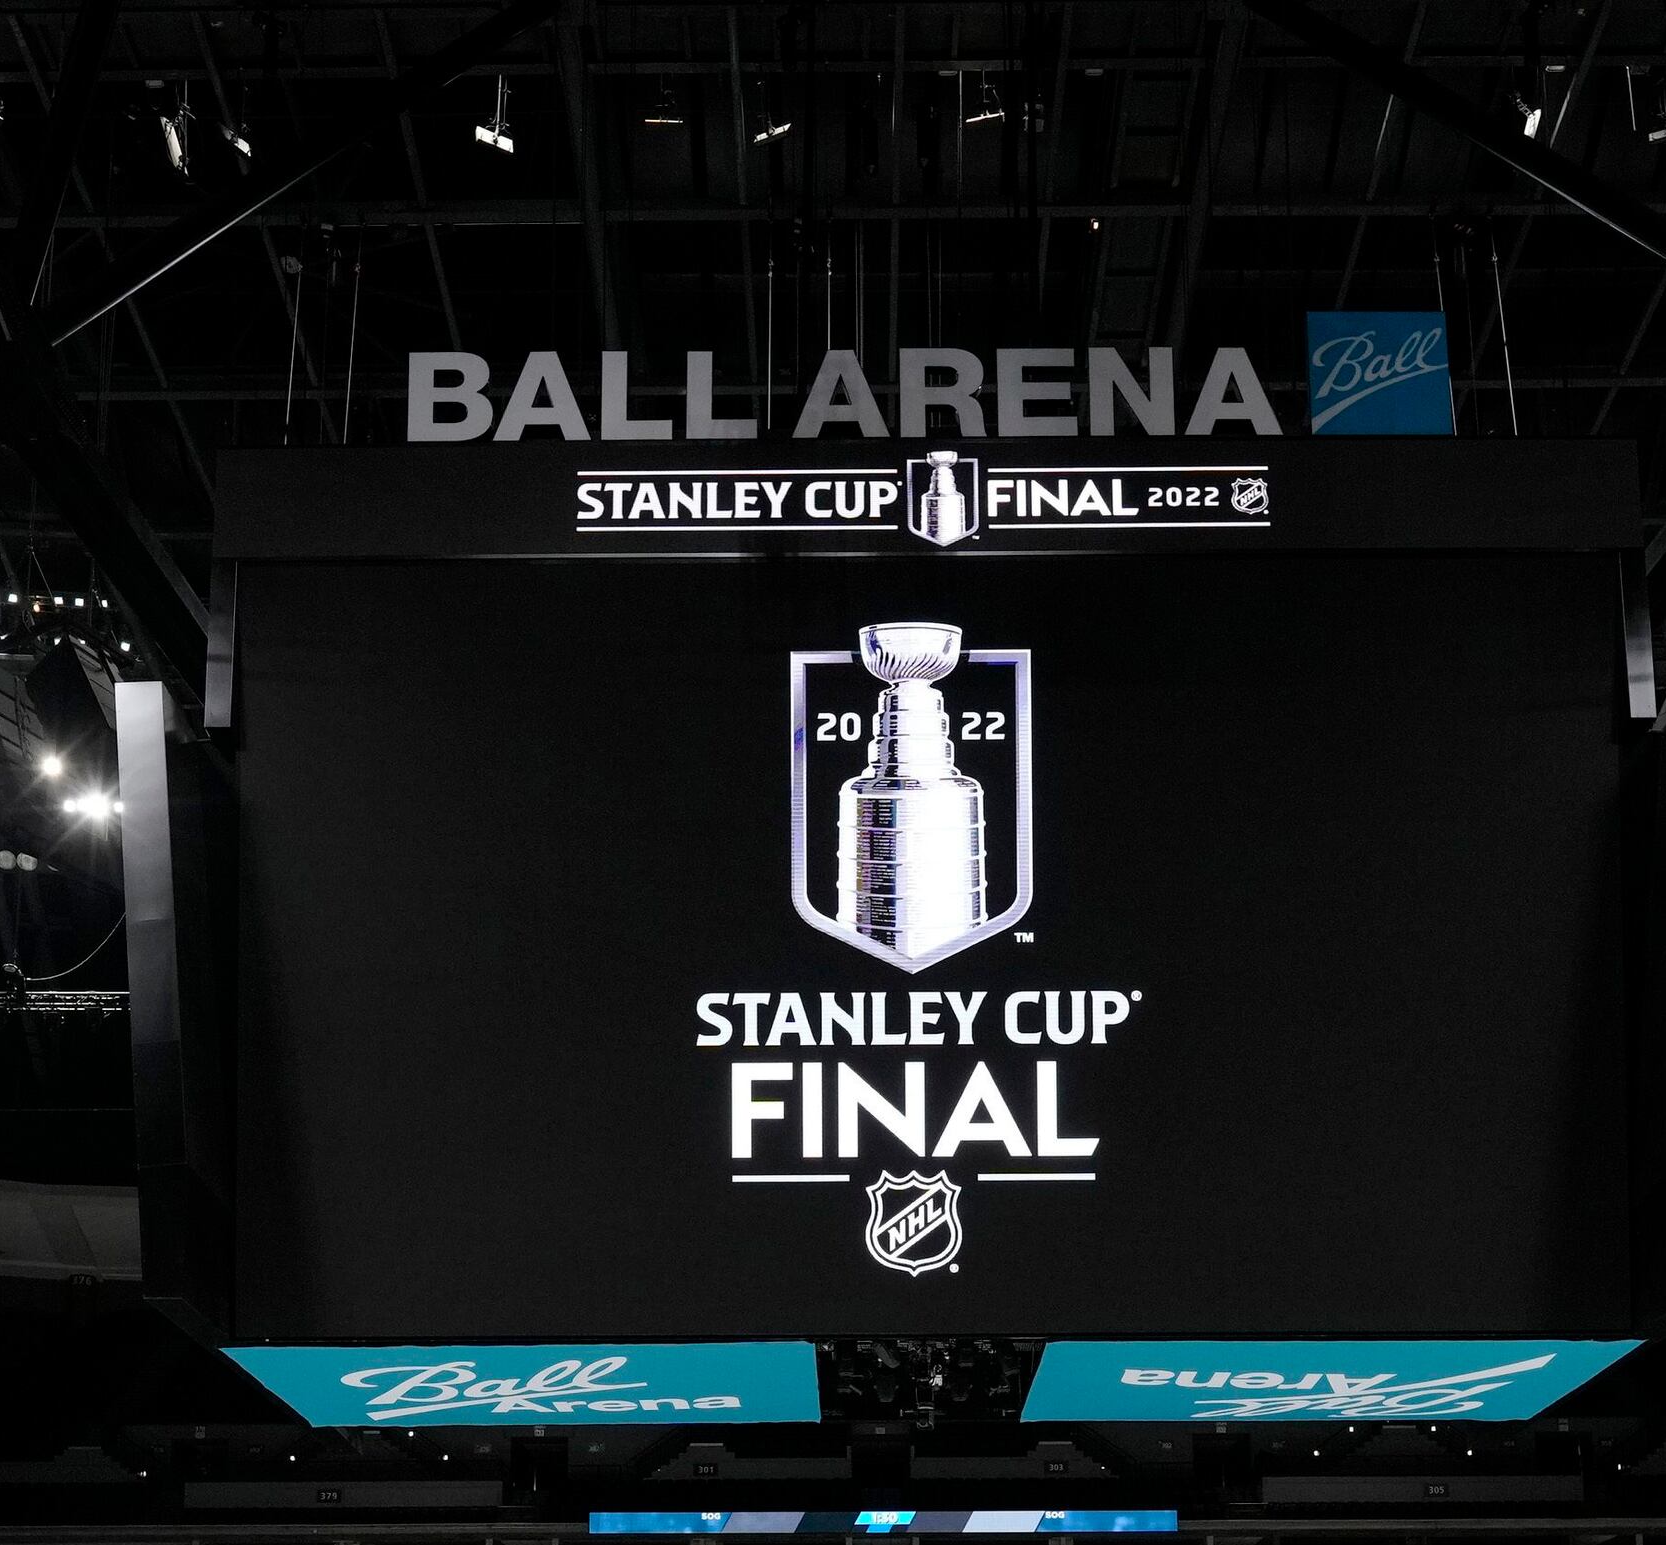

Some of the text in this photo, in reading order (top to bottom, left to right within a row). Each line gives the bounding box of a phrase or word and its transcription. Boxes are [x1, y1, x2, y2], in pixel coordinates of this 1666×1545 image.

[1312, 327, 1448, 400] Ball
[407, 347, 1285, 442] BALL ARENA
[576, 479, 1220, 520] STANLEY CUP FINAL 2022
[815, 710, 1007, 742] 20 22
[695, 990, 1132, 1047] STANLEY CUP
[731, 1060, 1100, 1159] FINAL
[886, 1193, 944, 1251] NHL
[340, 1356, 627, 1407] Ball
[1120, 1368, 1398, 1397] Arena
[1190, 1381, 1514, 1418] Ball
[491, 1395, 742, 1413] Arena
[701, 1512, 721, 1521] SOG
[1045, 1512, 1065, 1520] SOG
